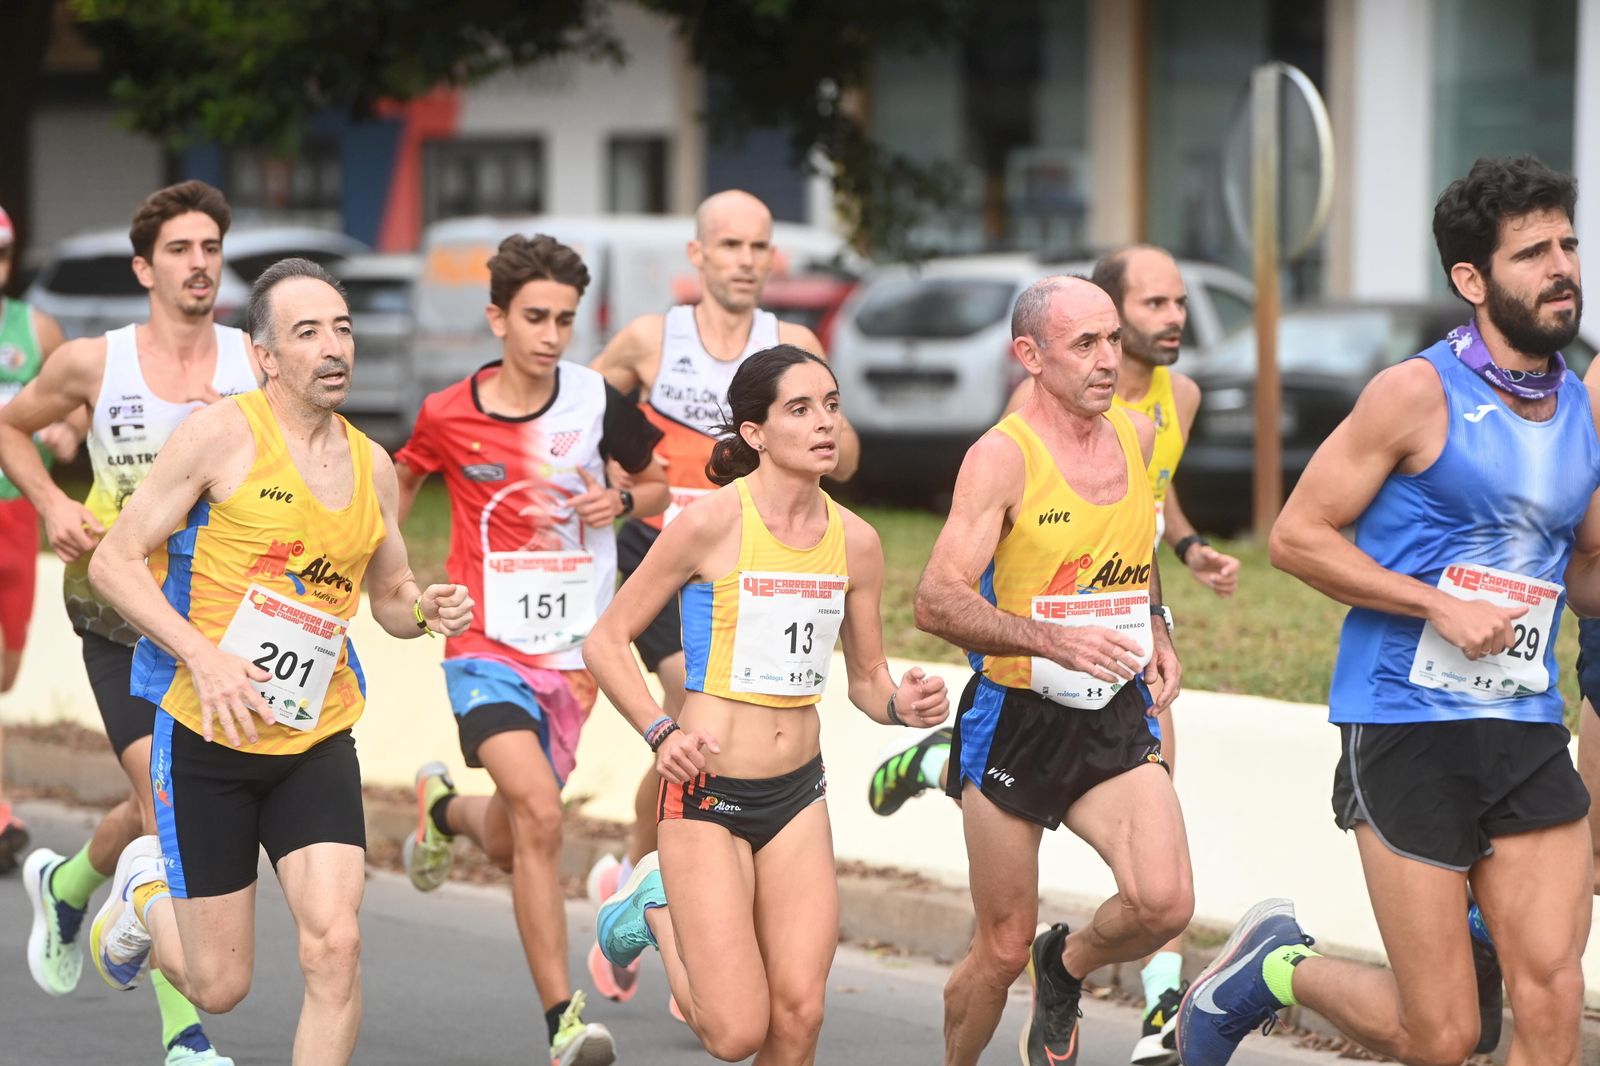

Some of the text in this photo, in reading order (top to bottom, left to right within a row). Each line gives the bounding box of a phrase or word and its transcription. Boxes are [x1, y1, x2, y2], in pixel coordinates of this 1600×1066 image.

[109, 404, 144, 419] gross
[299, 553, 353, 593] Álora
[489, 558, 515, 573] 42
[1088, 551, 1151, 588] Álora
[743, 578, 774, 597] 42
[775, 579, 817, 590] CARRERA
[1446, 566, 1559, 600] 42 CARRERA URBANA
[311, 590, 338, 605] Málaga
[801, 589, 832, 599] MALAGA
[1507, 590, 1542, 607] MALAGA
[249, 589, 281, 618] 42
[279, 603, 322, 627] CARRERA
[518, 592, 567, 619] 151
[1035, 596, 1149, 619] 42 CARRERA URBANA
[1095, 606, 1131, 617] MALAGA
[1115, 622, 1145, 630] FEDERADO
[784, 622, 814, 654] 13
[1500, 623, 1540, 661] 29
[314, 645, 336, 657] FEDERADO
[251, 641, 315, 688] 201
[714, 799, 742, 812] Álora
